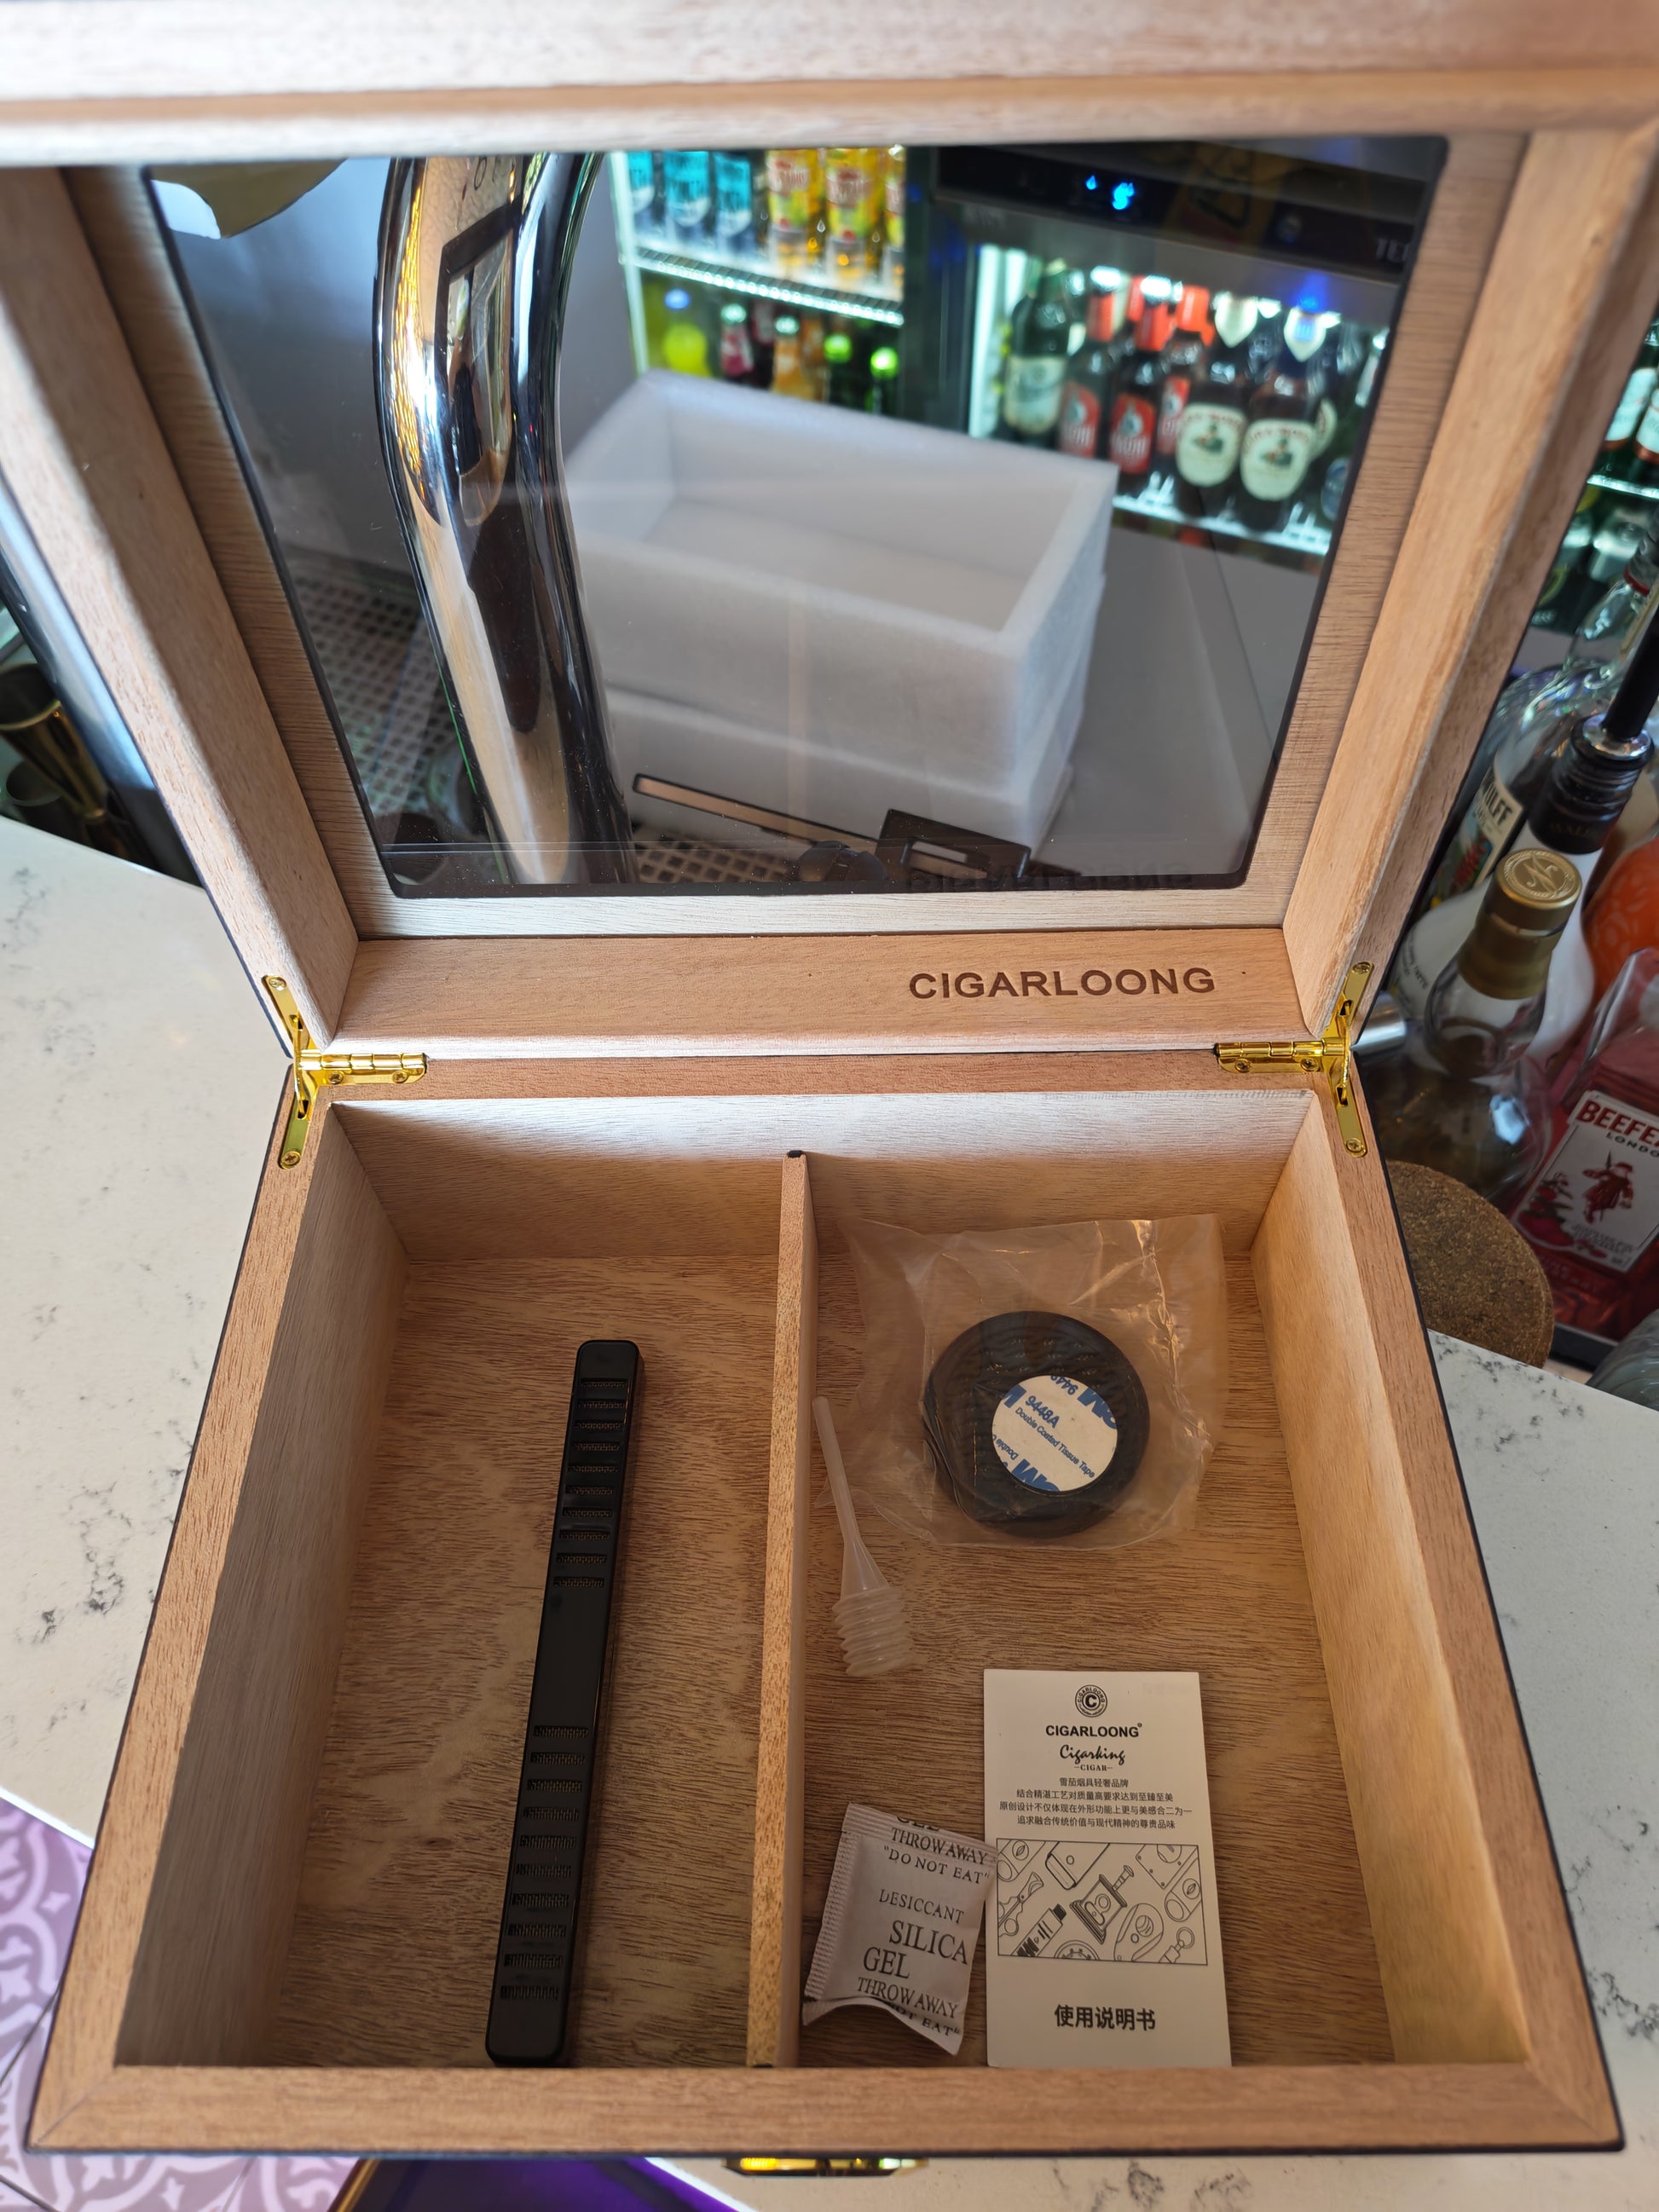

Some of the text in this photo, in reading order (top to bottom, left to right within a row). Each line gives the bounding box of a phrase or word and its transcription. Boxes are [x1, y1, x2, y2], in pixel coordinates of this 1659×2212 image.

[909, 967, 1215, 999] CIGARLOONG
[1025, 1395, 1060, 1429] 9448A
[1015, 1406, 1095, 1478] Double Coated Tissue Tape
[1045, 1724, 1140, 1738] CIGARLOONG
[1060, 1744, 1126, 1765] Cigarking
[1080, 1764, 1107, 1772] CIGAR
[1059, 1777, 1129, 1788] 雪茄烟具轻奢品牌
[999, 1801, 1193, 1816] 原创设计不仅体现在外形功能上更与美感合二为一
[1017, 1815, 1176, 1829] 追求融合传统价值与现代精神的尊贵品味
[892, 1827, 989, 1866] THROW AWAY
[915, 1853, 949, 1874] NOT
[879, 1889, 964, 1925] DESICCANT
[889, 1920, 968, 1965] SILICA
[863, 1946, 910, 1979] GEL
[858, 1977, 958, 2019] THROW AWAY
[1055, 2004, 1156, 2031] 使用说明书
